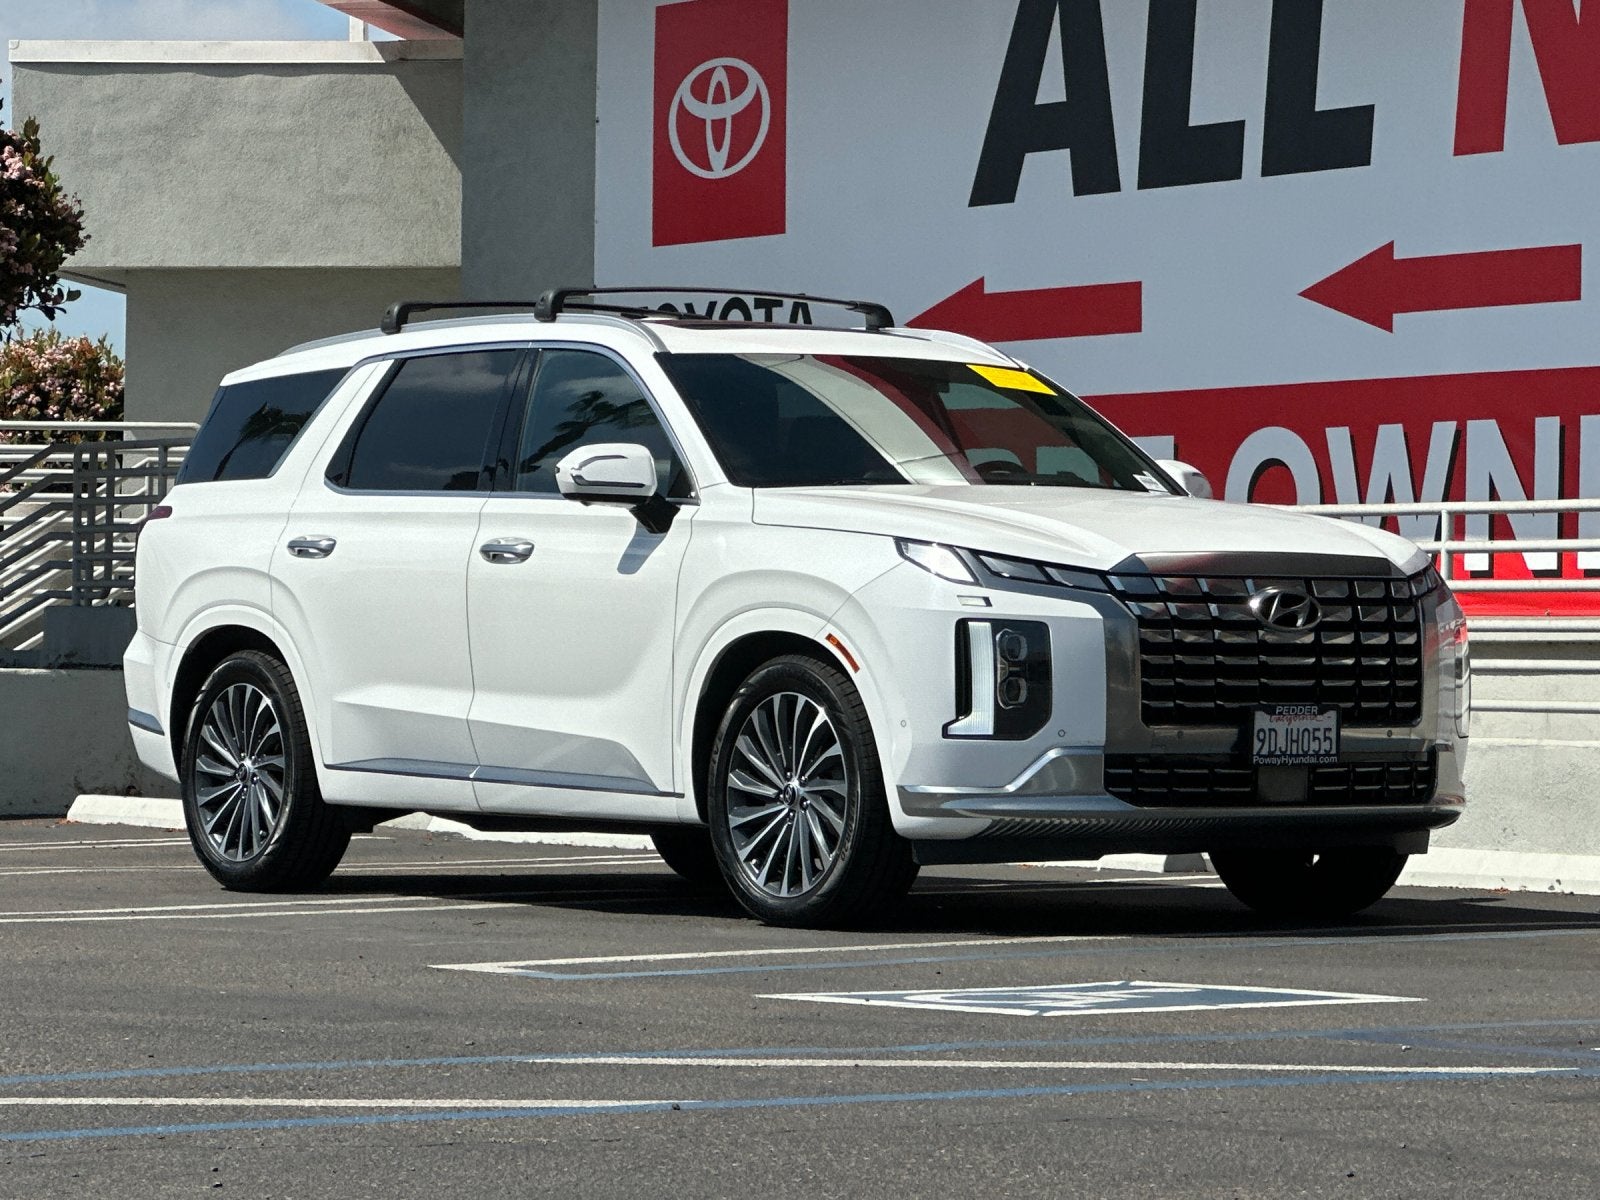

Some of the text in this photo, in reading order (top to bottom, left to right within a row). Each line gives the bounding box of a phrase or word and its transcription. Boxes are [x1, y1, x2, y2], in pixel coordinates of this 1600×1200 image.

[967, 0, 1375, 207] ALL
[644, 296, 812, 324] YOTA
[1225, 414, 1600, 570] OWN
[1275, 705, 1318, 715] PEDDER
[1255, 727, 1333, 754] 9DJH055
[1253, 755, 1338, 766] PowayHyundai.com
